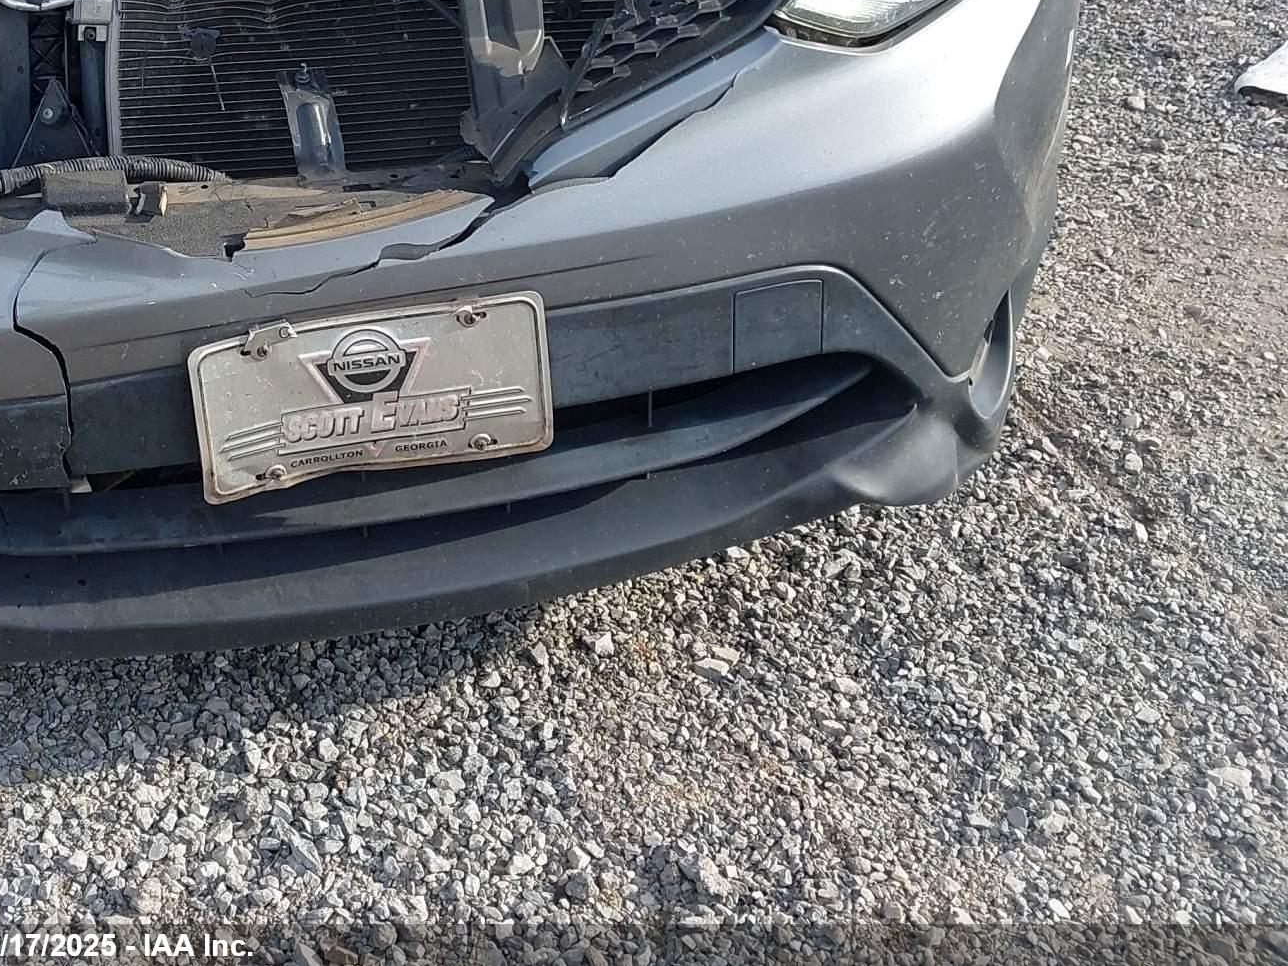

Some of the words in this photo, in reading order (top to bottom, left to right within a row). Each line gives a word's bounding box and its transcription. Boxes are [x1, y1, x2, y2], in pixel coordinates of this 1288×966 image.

[333, 355, 400, 372] NISSAN
[284, 408, 364, 443] SCOTT
[290, 450, 363, 468] CARROLLTON
[395, 439, 448, 453] GEORGIA
